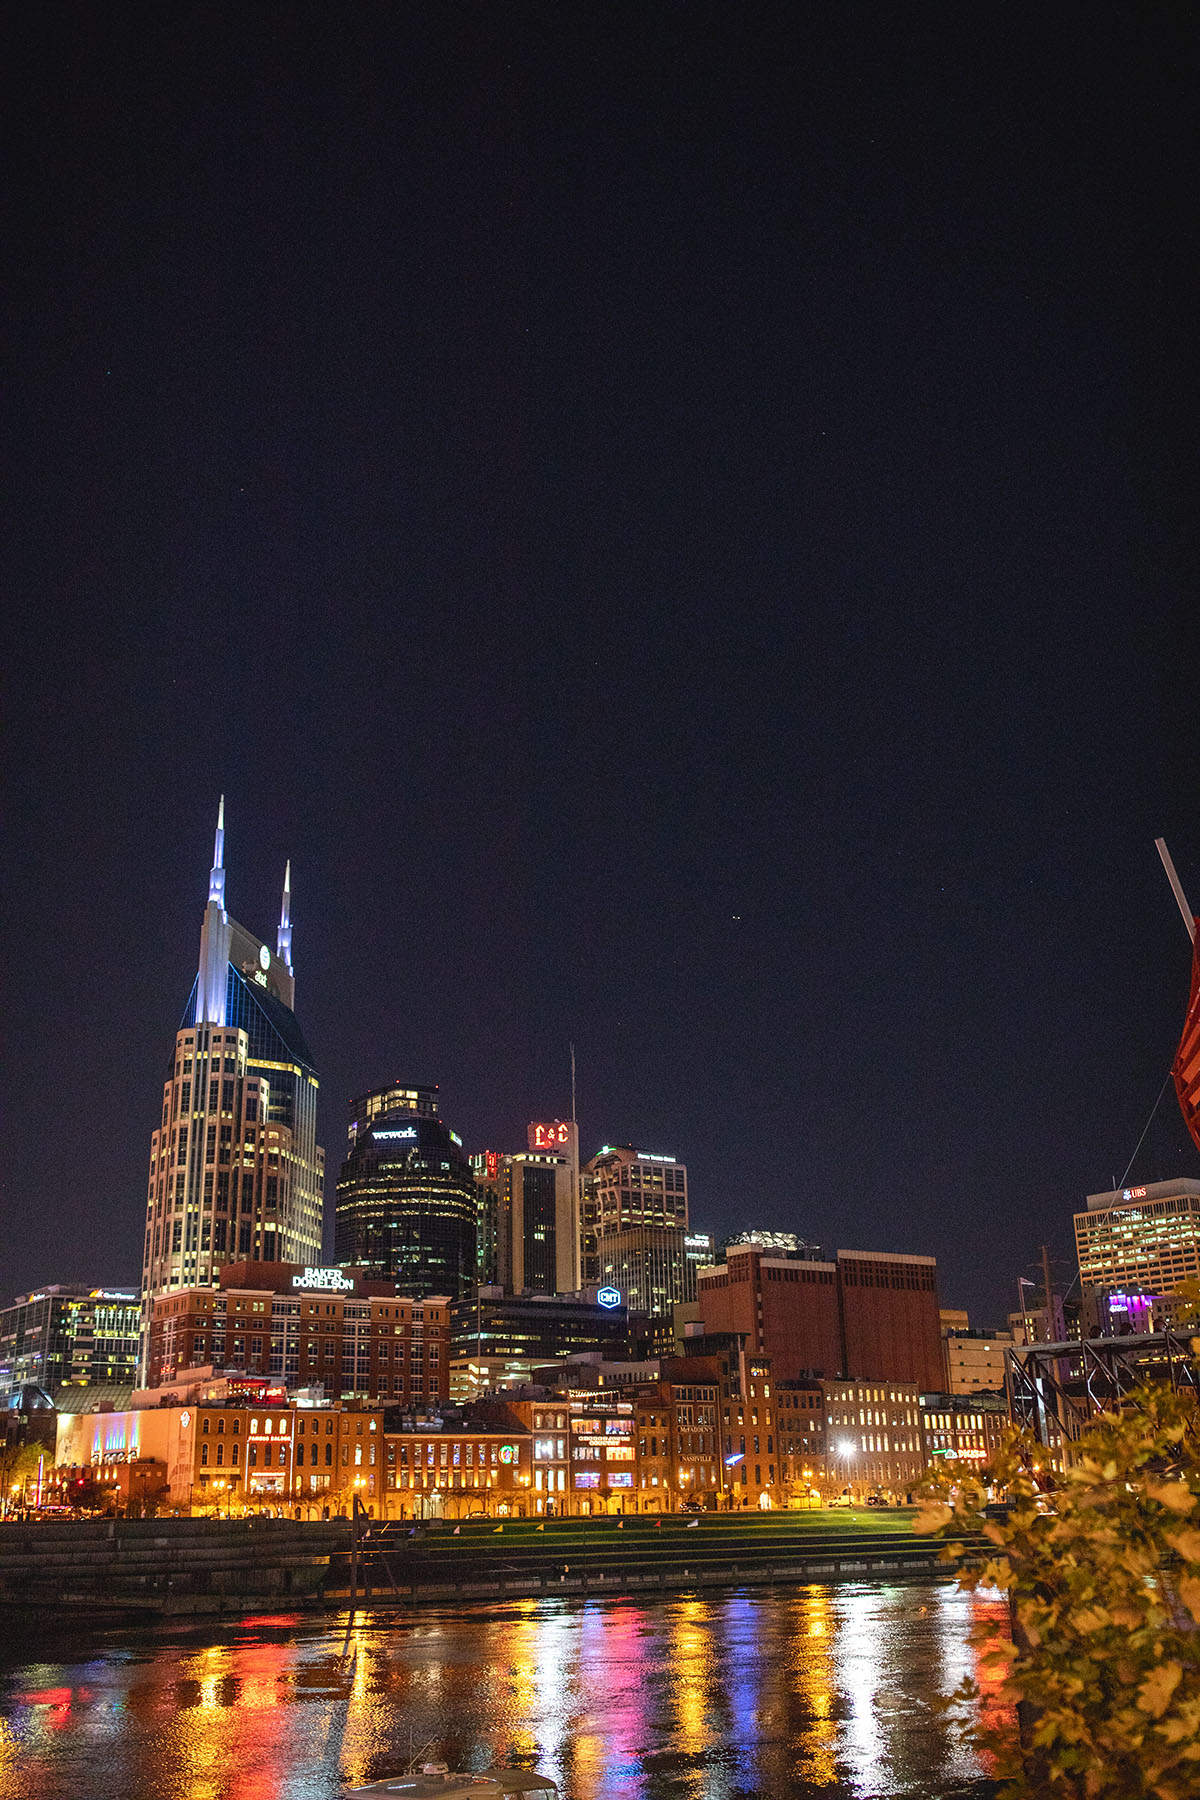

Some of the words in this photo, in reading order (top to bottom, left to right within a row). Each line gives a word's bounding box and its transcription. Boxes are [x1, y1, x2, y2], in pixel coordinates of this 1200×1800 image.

[372, 1127, 417, 1140] wework
[1131, 1187, 1147, 1199] UBS
[304, 1267, 343, 1281] BAKER
[292, 1276, 354, 1290] DONELSON
[600, 1292, 619, 1303] CMT
